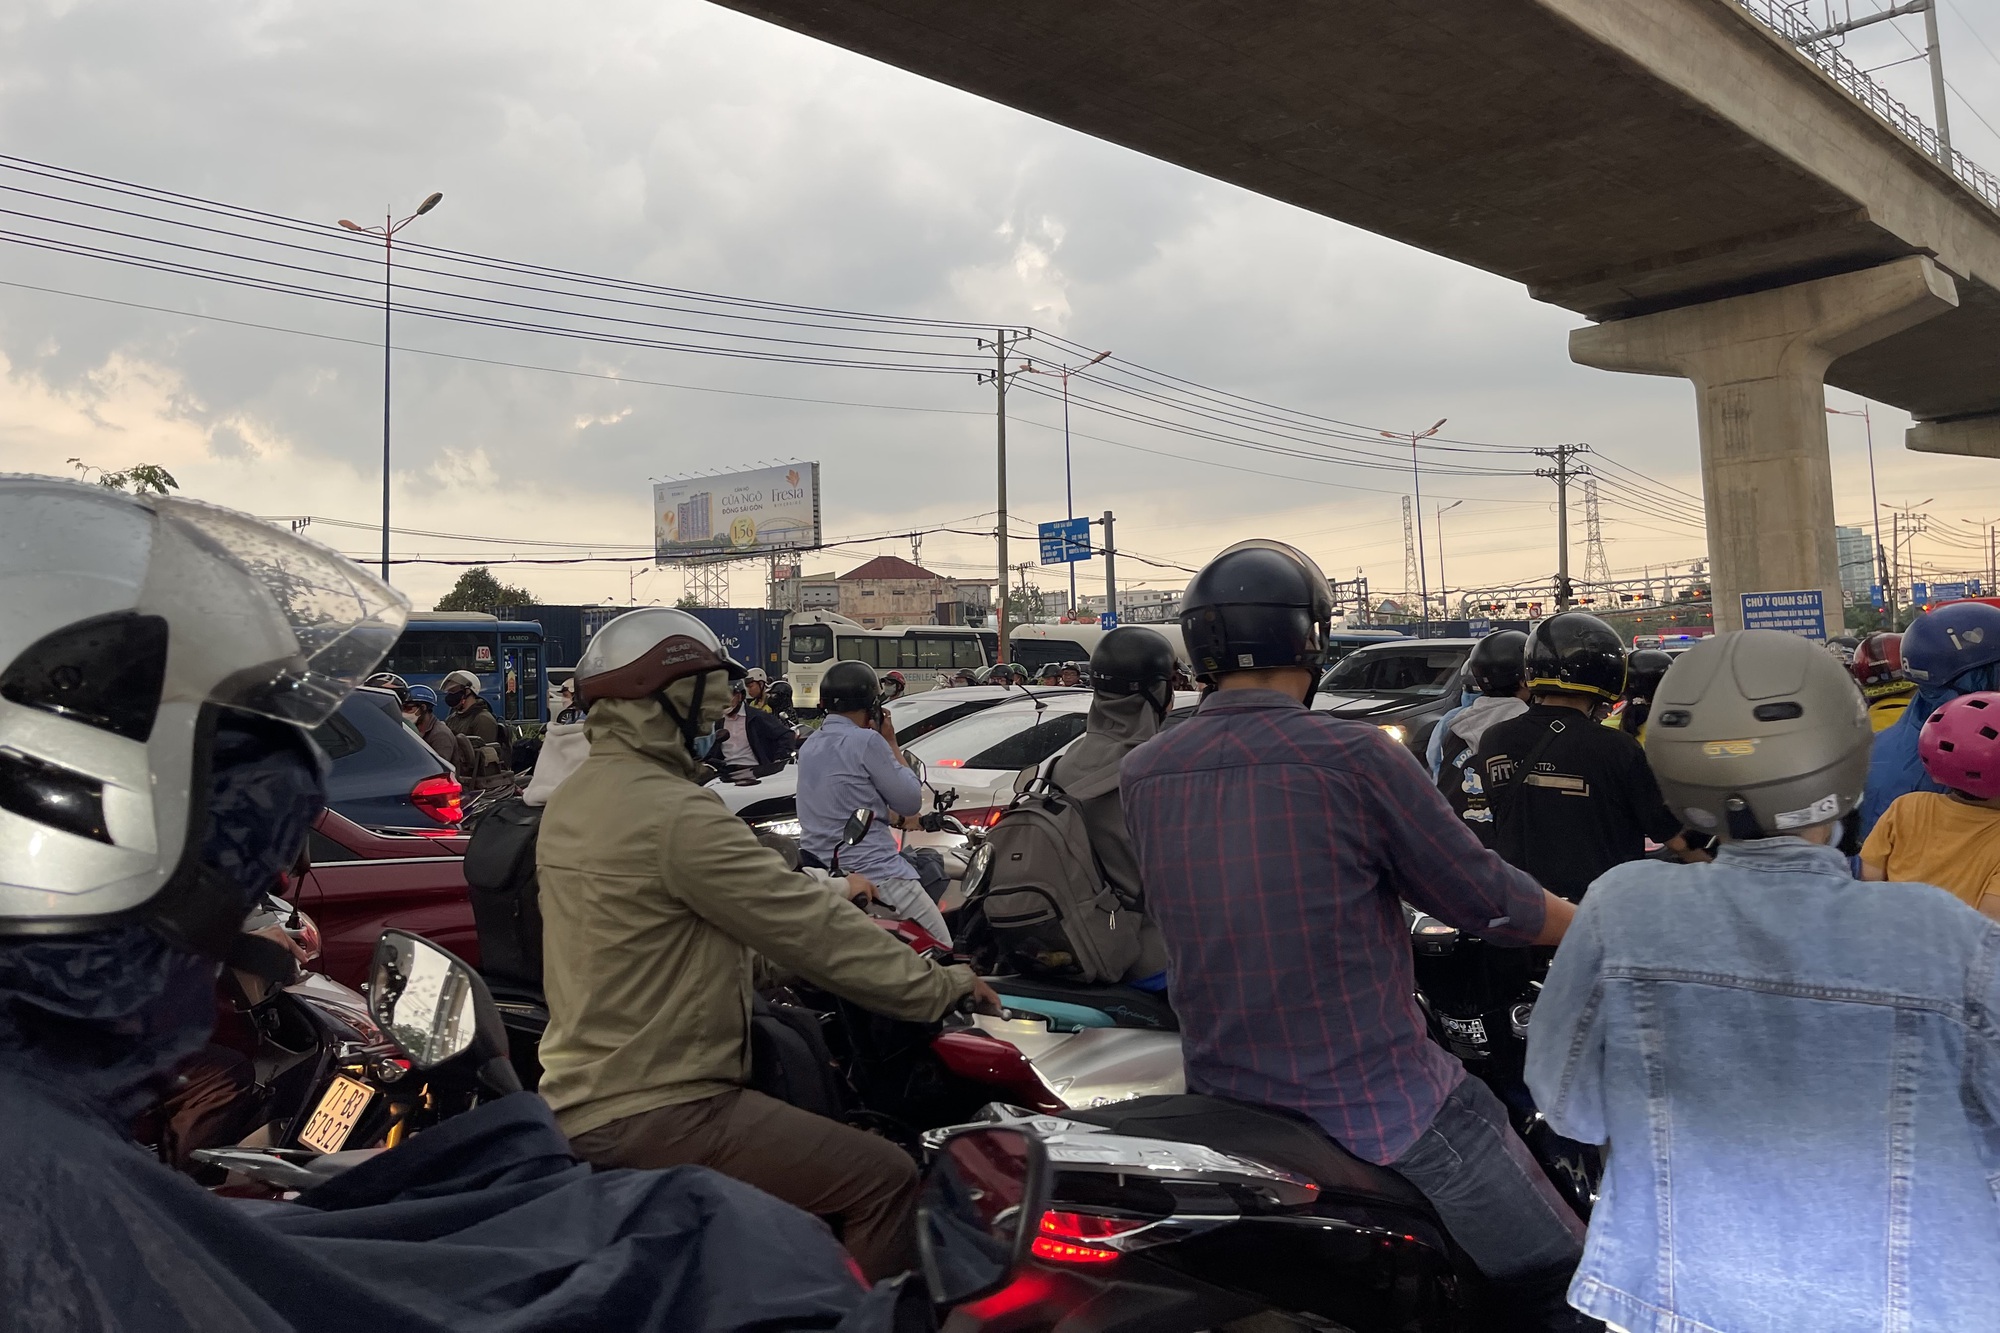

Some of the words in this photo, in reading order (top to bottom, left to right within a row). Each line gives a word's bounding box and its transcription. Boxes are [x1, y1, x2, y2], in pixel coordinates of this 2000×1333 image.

[771, 488, 804, 502] Fresia
[1745, 595, 1763, 607] CHÚ
[1772, 595, 1796, 607] QUAN
[1797, 593, 1813, 605] SÁT
[720, 633, 740, 649] ine
[477, 648, 490, 659] 150
[904, 672, 921, 682] REEN
[1454, 749, 1474, 769] ADR
[1491, 764, 1512, 781] FIT
[325, 1081, 365, 1119] 71-B3
[304, 1110, 350, 1152] 679.27
